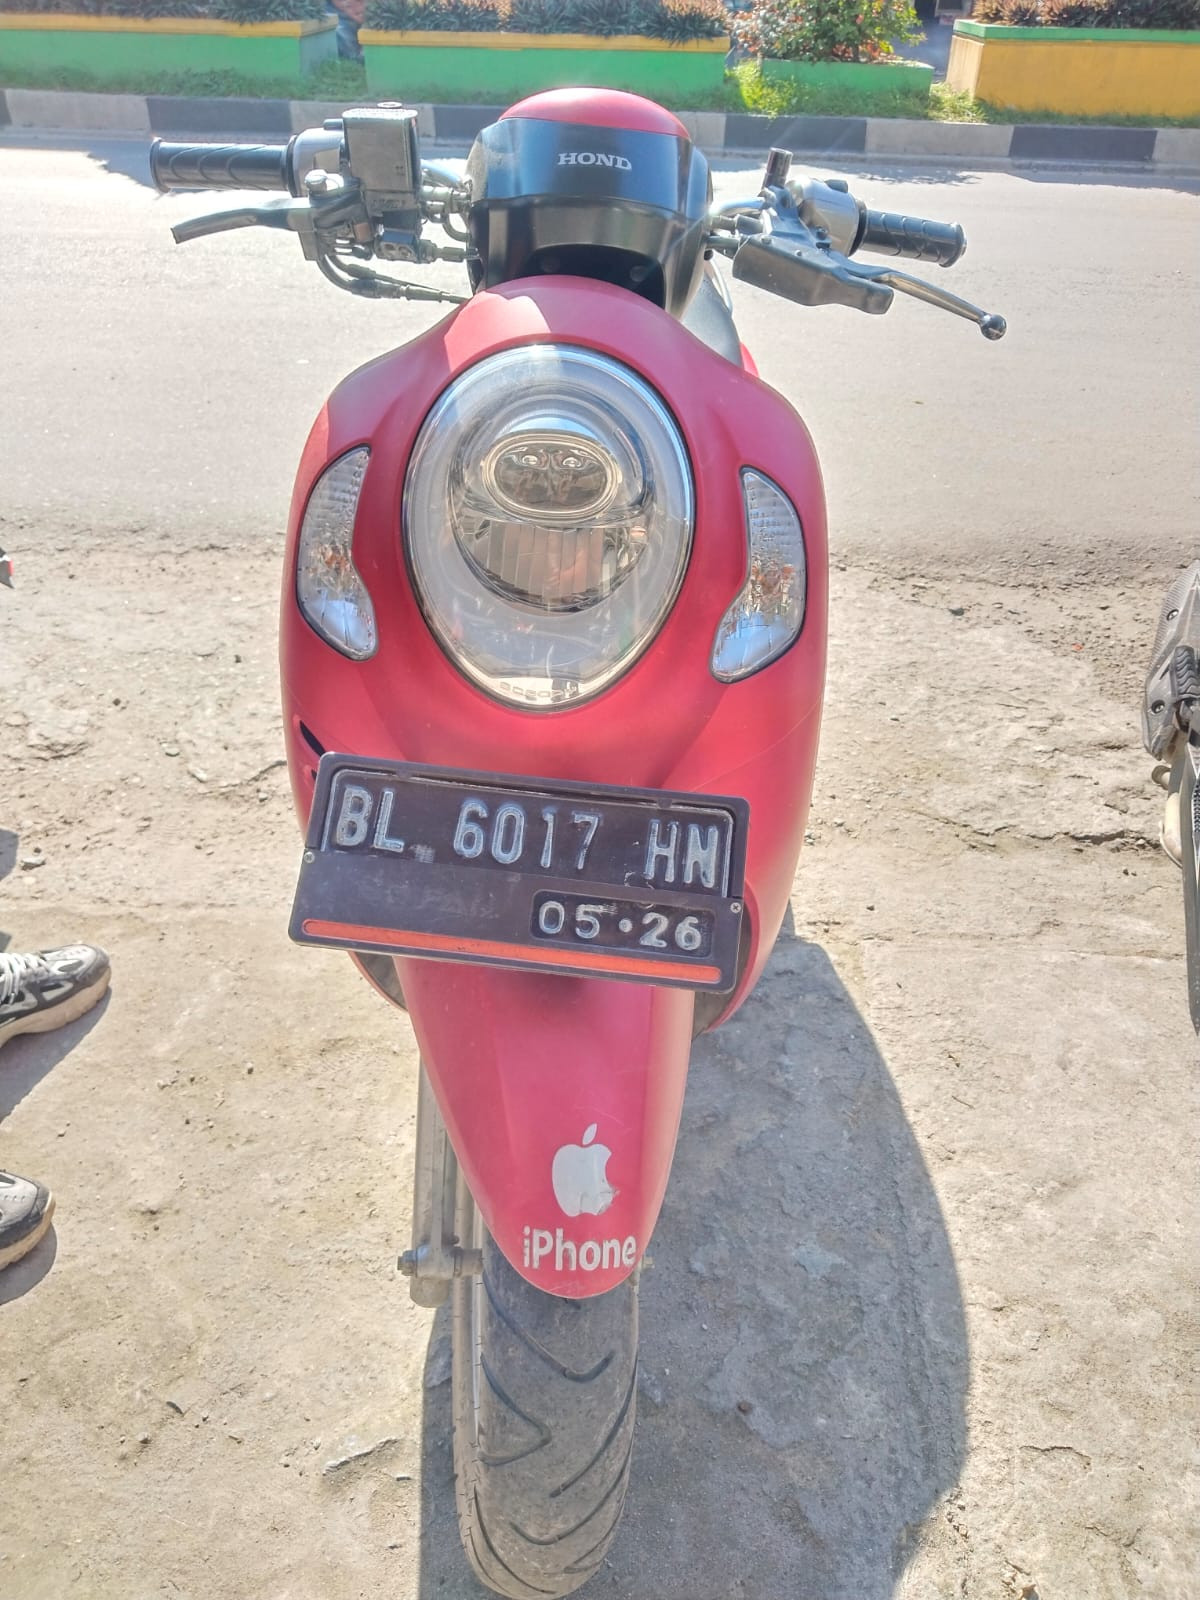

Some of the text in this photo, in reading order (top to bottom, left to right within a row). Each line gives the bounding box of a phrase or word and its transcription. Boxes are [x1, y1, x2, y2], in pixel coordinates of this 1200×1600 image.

[557, 152, 632, 171] HOND
[336, 785, 719, 888] BL 6017 HN
[523, 1225, 637, 1271] iPhone
